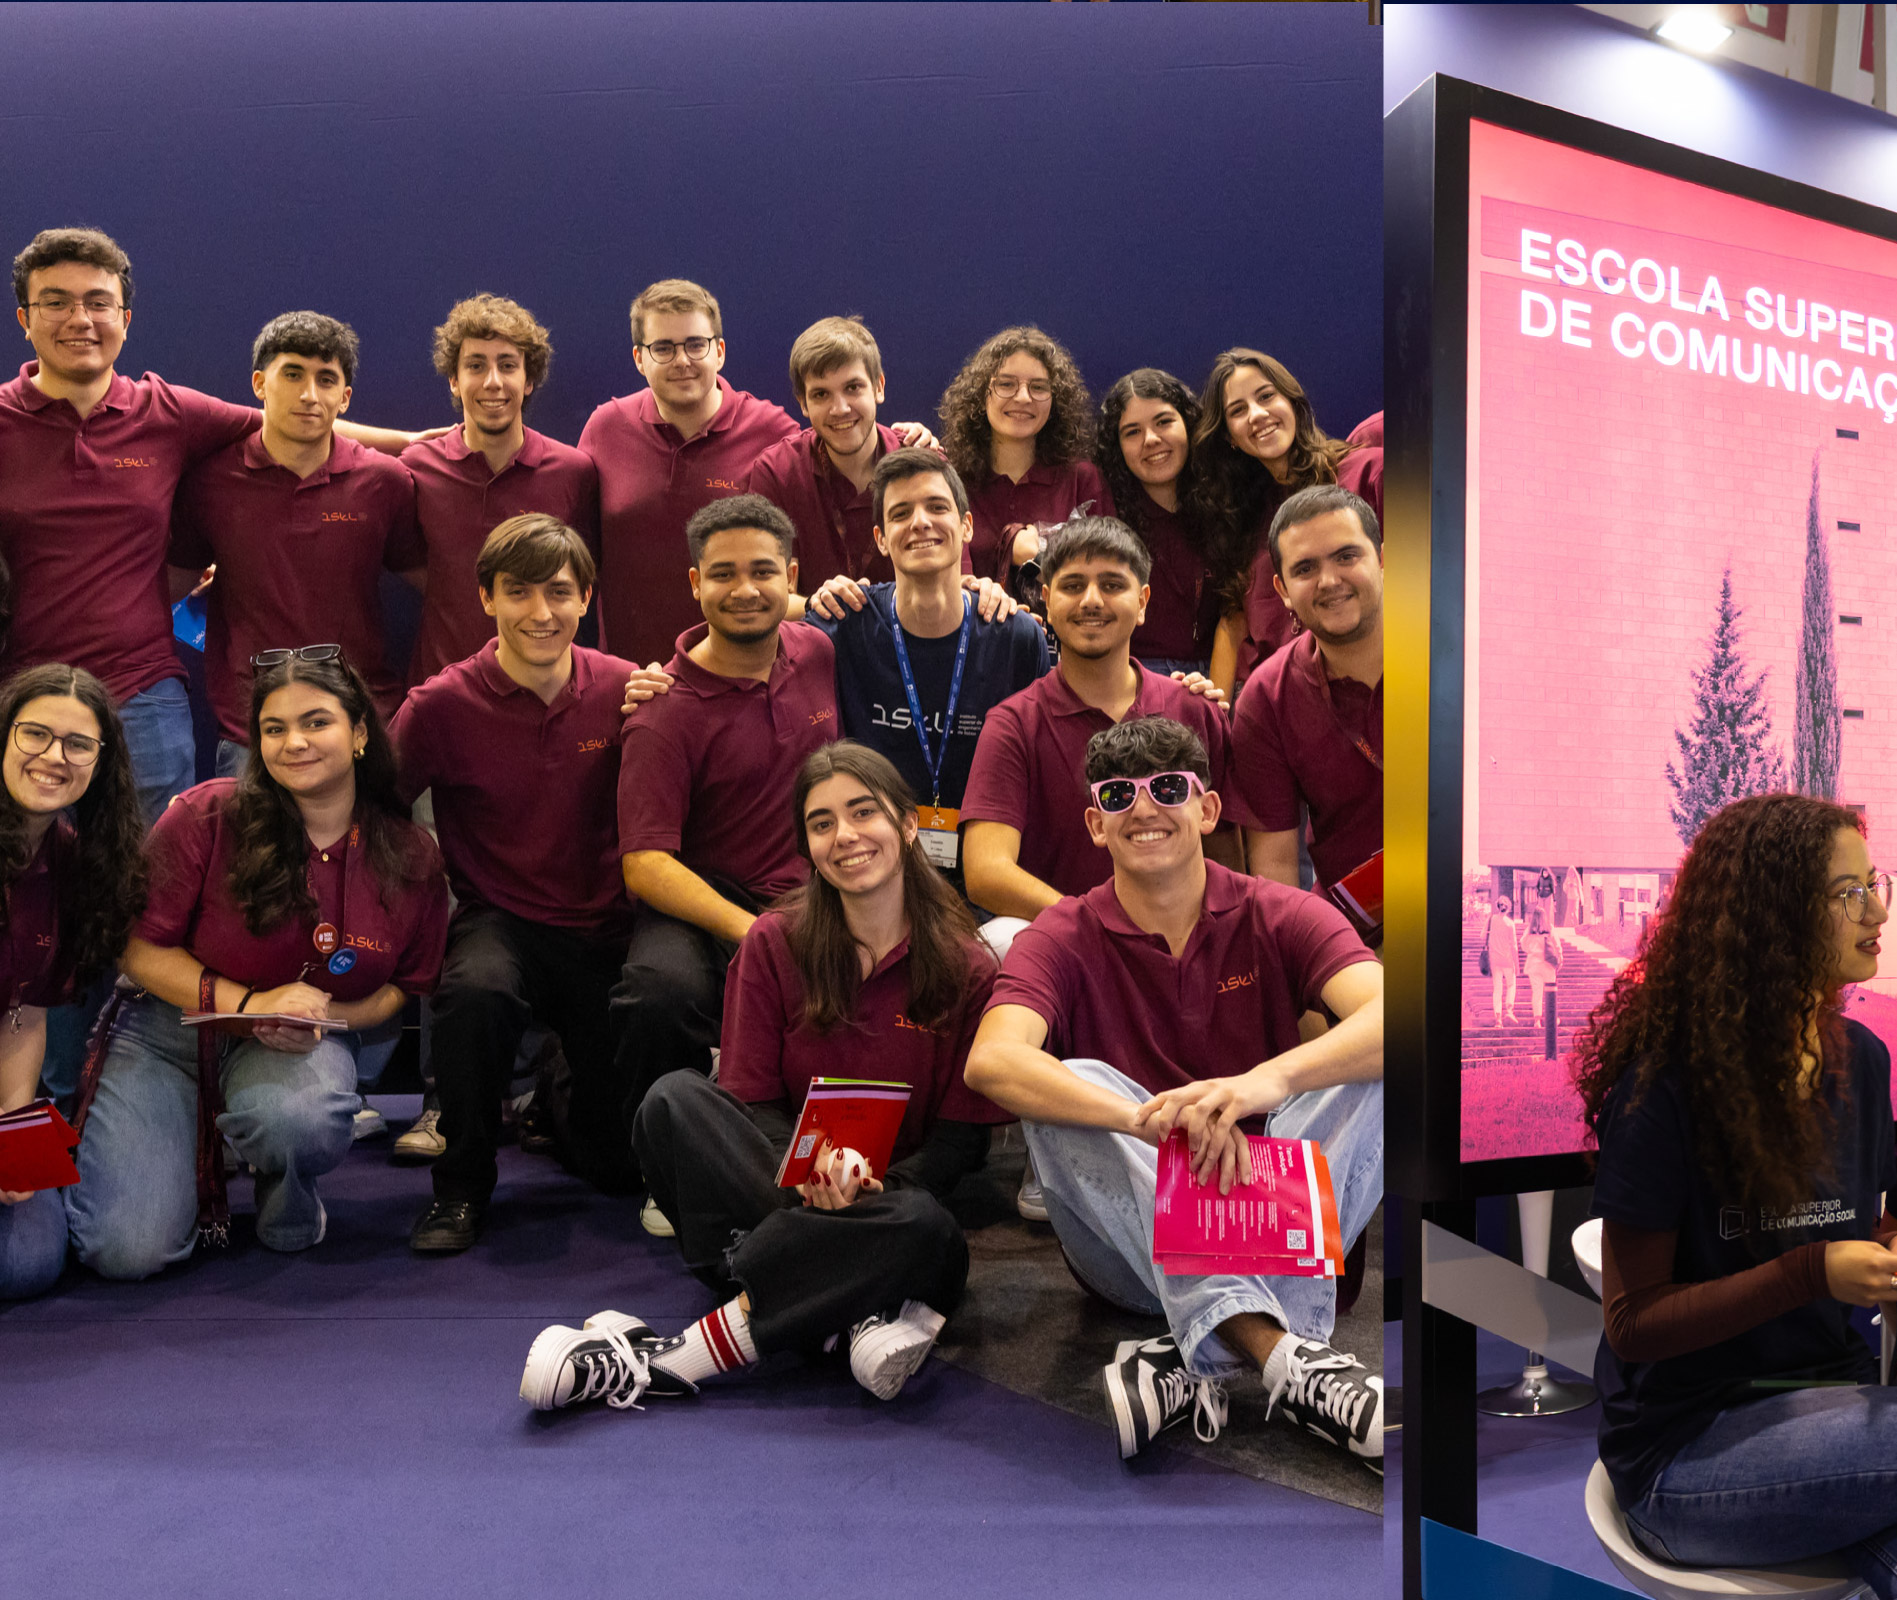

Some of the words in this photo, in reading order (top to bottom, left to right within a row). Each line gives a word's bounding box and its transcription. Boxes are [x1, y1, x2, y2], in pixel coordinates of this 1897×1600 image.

[1521, 229, 1730, 322] ESCOLA
[1520, 291, 1592, 349] DE
[1800, 1199, 1841, 1212] SUPERIOR
